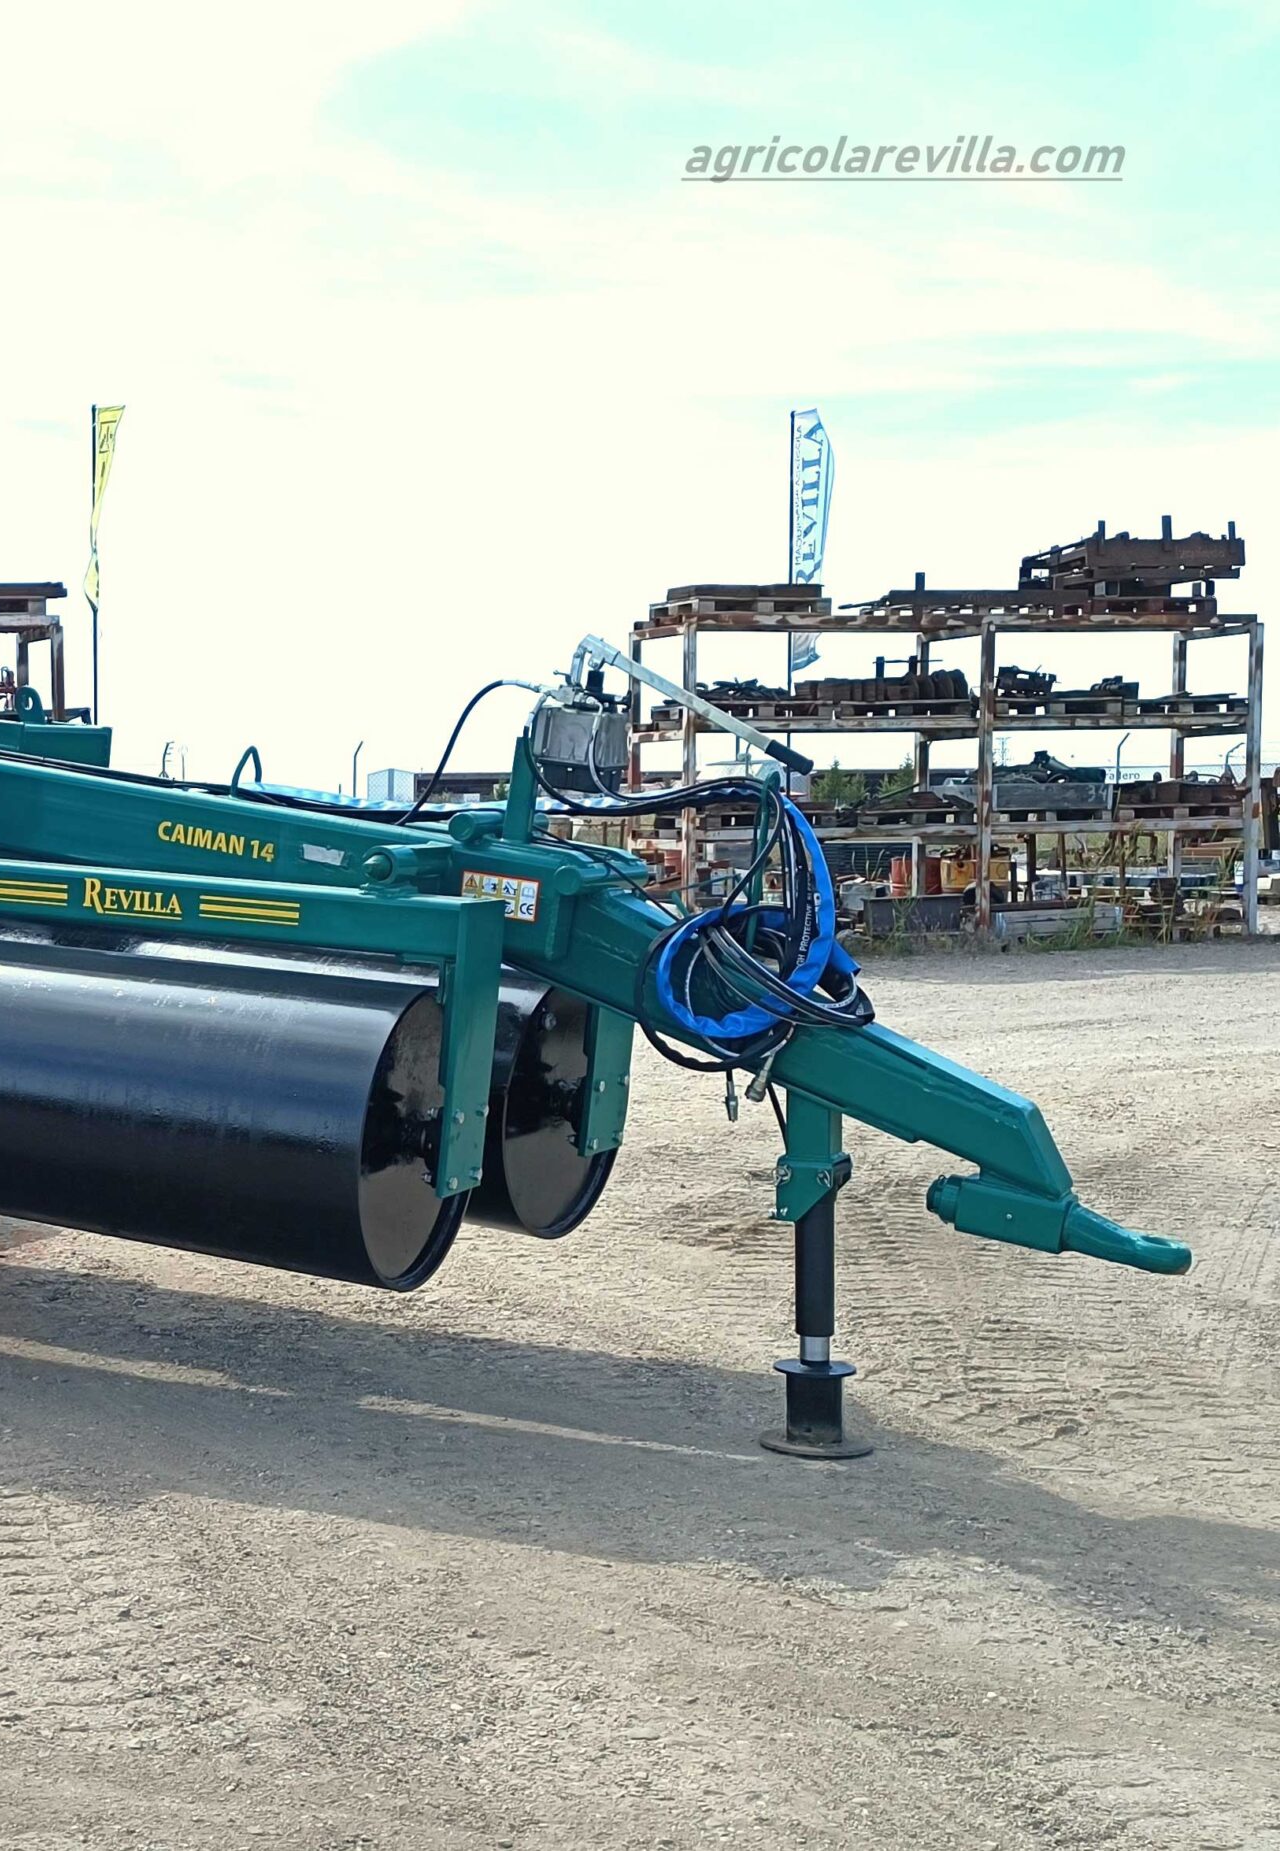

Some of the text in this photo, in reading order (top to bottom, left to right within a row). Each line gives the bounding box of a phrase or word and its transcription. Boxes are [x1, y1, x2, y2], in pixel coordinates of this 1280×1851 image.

[796, 421, 823, 586] REVILLA
[158, 821, 275, 862] CAIMAN 14
[83, 877, 182, 918] REVILLA
[520, 902, 534, 915] CE
[800, 904, 812, 952] PROTECTIVE
